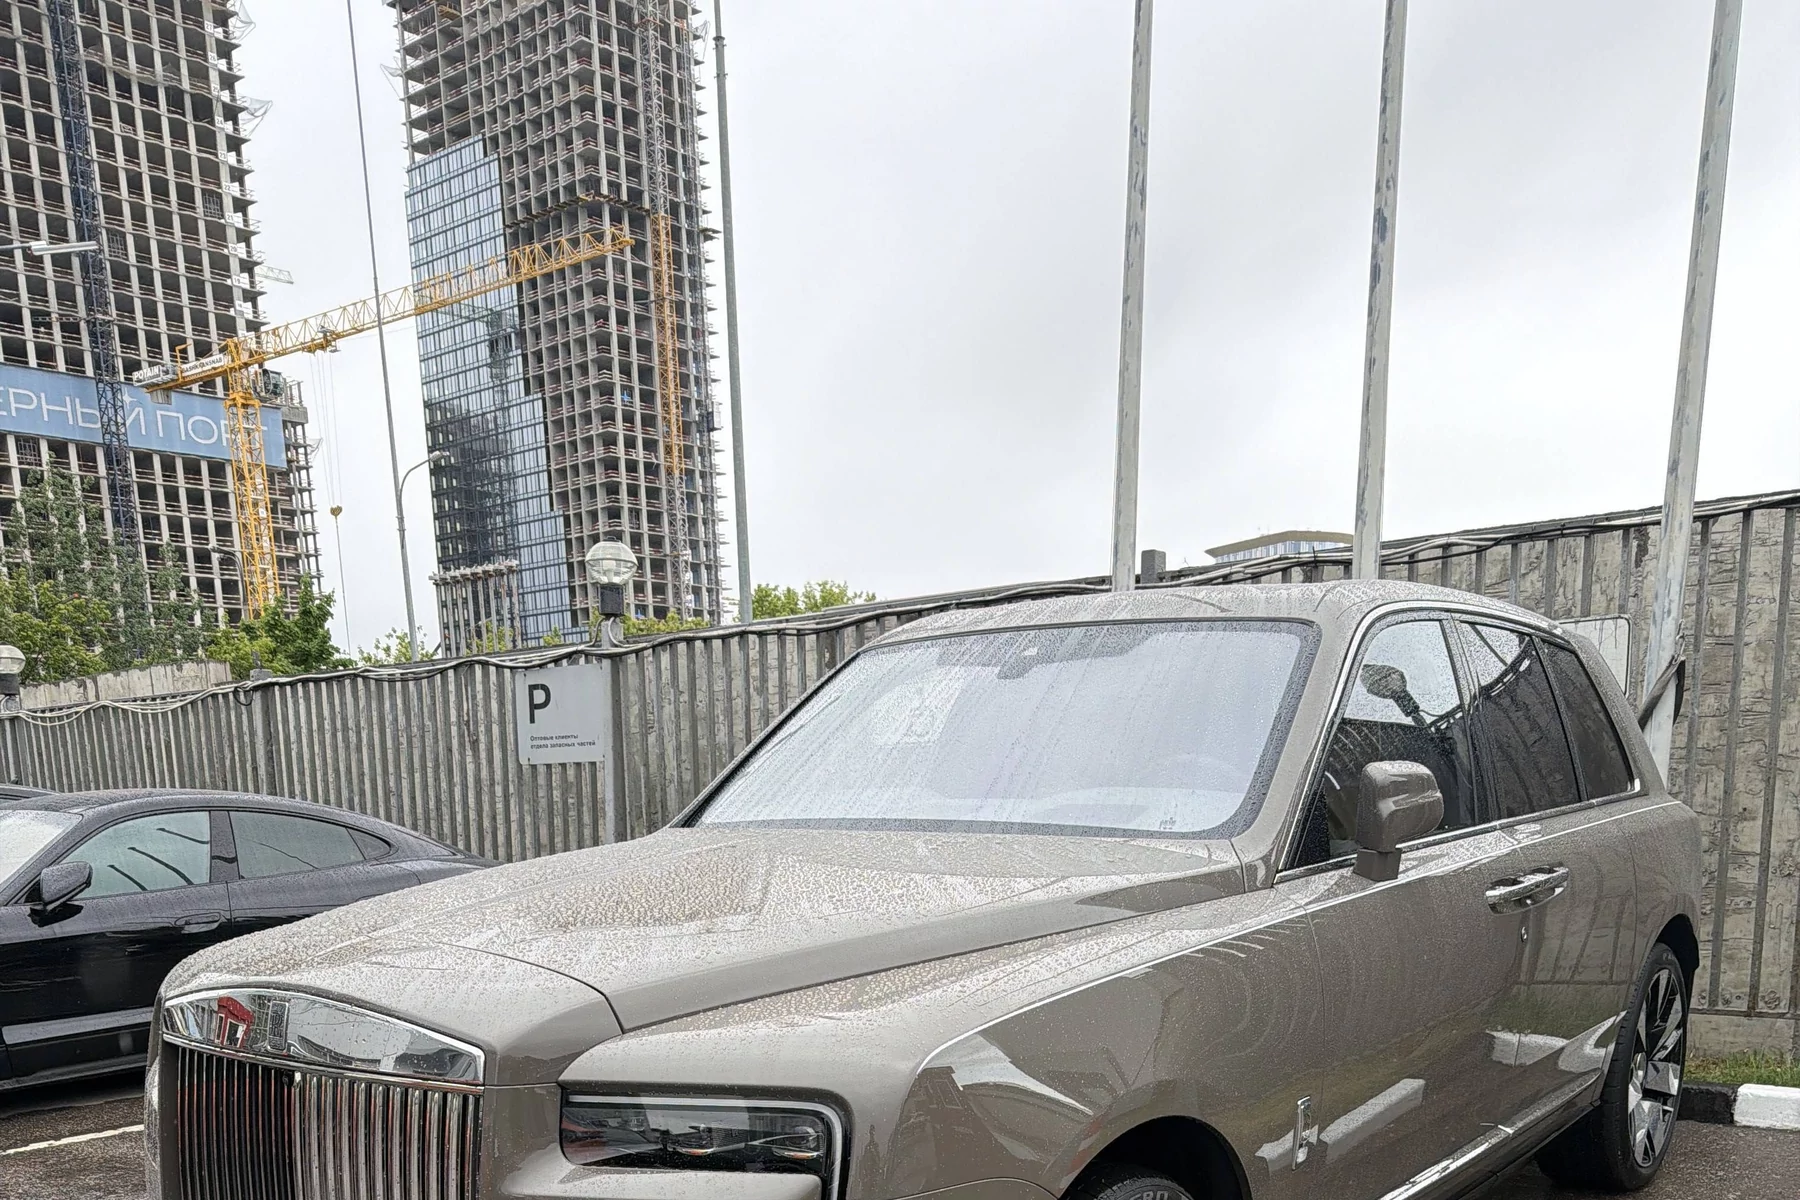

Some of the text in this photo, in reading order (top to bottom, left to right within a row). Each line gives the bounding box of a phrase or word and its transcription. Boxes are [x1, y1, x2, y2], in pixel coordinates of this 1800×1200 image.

[223, 183, 231, 191] 22
[133, 364, 161, 379] POTAIN
[528, 683, 551, 724] P
[577, 739, 596, 747] частей
